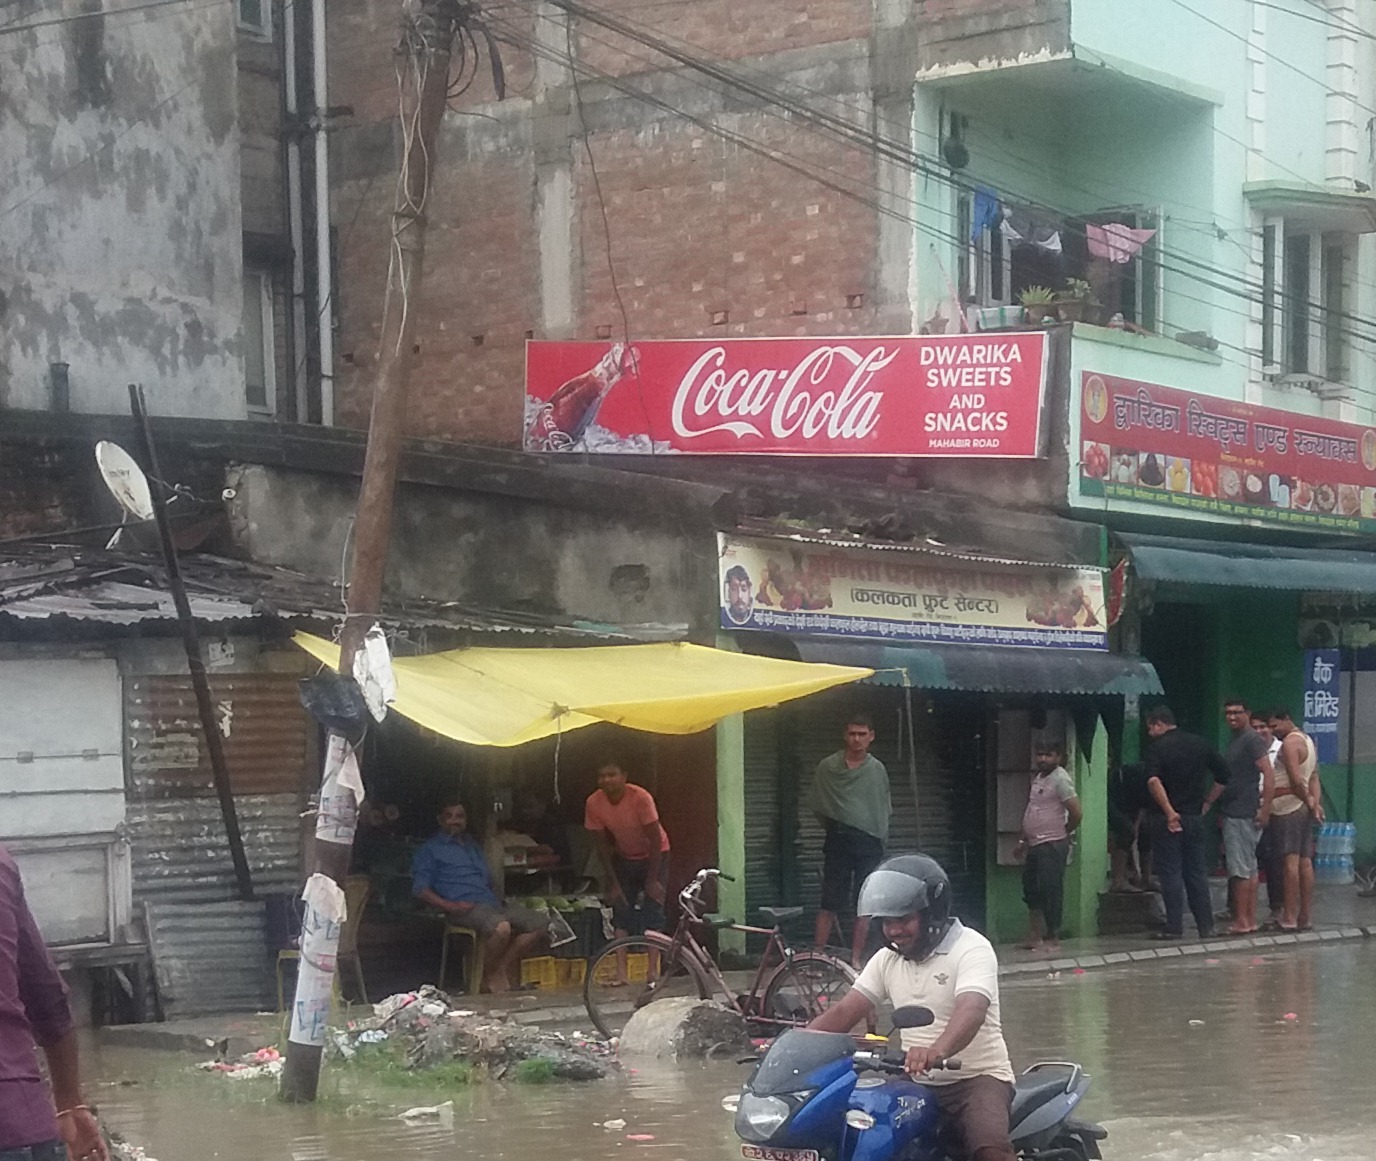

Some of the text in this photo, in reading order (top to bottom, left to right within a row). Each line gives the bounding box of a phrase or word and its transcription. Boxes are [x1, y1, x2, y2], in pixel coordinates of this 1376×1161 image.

[920, 343, 1022, 365] DWARIKA
[926, 366, 1012, 387] SWEETS
[671, 346, 901, 439] Coca-Cola
[949, 393, 985, 409] AND
[924, 411, 1008, 432] SNACKS
[929, 438, 1000, 448] MAHABIR ROAD
[1254, 422, 1289, 455] एण्ड
